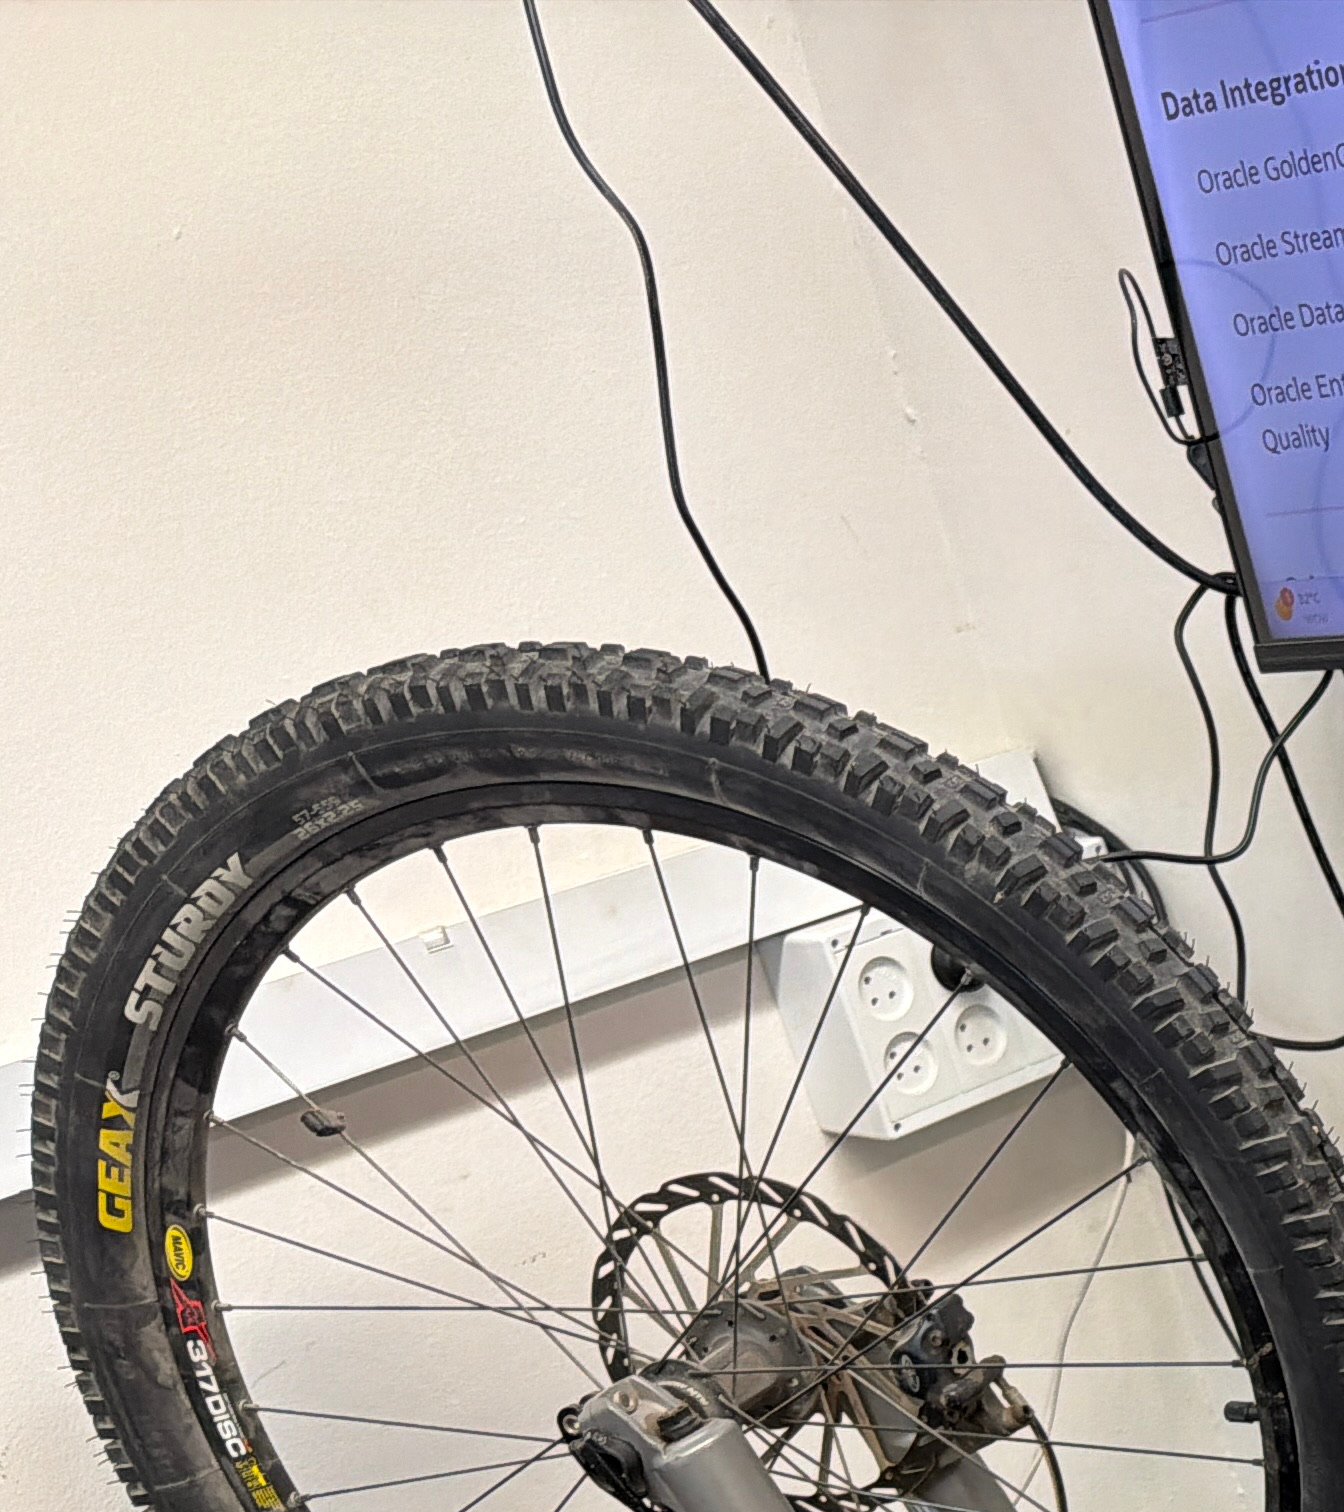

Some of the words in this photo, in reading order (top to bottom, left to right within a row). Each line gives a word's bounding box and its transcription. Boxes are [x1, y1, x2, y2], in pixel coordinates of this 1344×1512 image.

[1160, 88, 1218, 121] Data
[1196, 159, 1261, 194] Oracle
[1214, 232, 1279, 266] Oracle
[1232, 304, 1296, 337] Oracle
[1249, 375, 1313, 406] Oracle
[1261, 423, 1330, 455] Quality
[124, 851, 255, 1031] STURDY
[97, 1084, 141, 1233] GEAX
[169, 1232, 187, 1277] MAVIC
